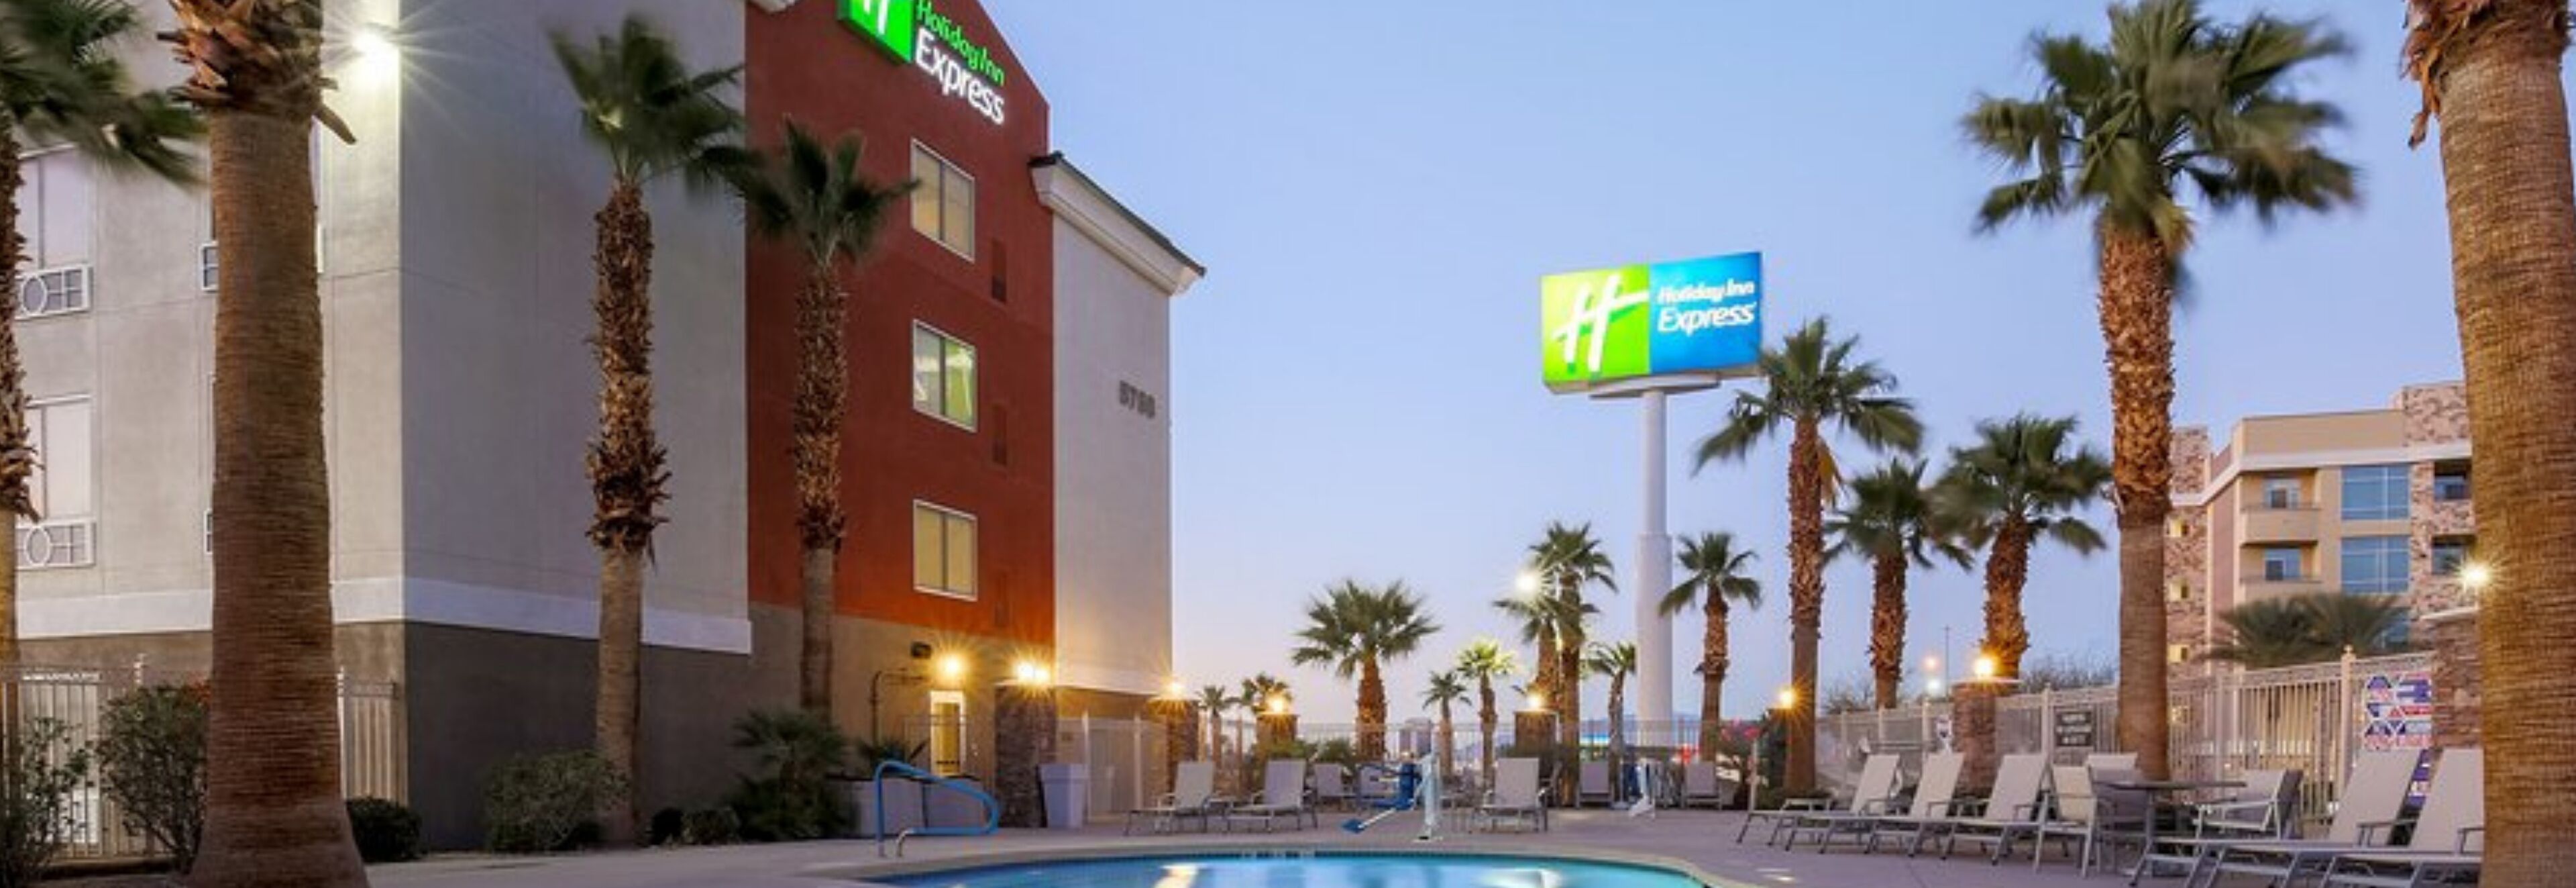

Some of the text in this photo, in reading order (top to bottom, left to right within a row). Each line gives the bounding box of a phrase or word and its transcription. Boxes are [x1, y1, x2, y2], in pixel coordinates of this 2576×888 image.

[916, 0, 979, 69] Holiday
[980, 46, 1005, 86] Inn
[915, 26, 1006, 126] Express
[1658, 277, 1755, 303] Holiday Inn
[1658, 305, 1755, 336] Express
